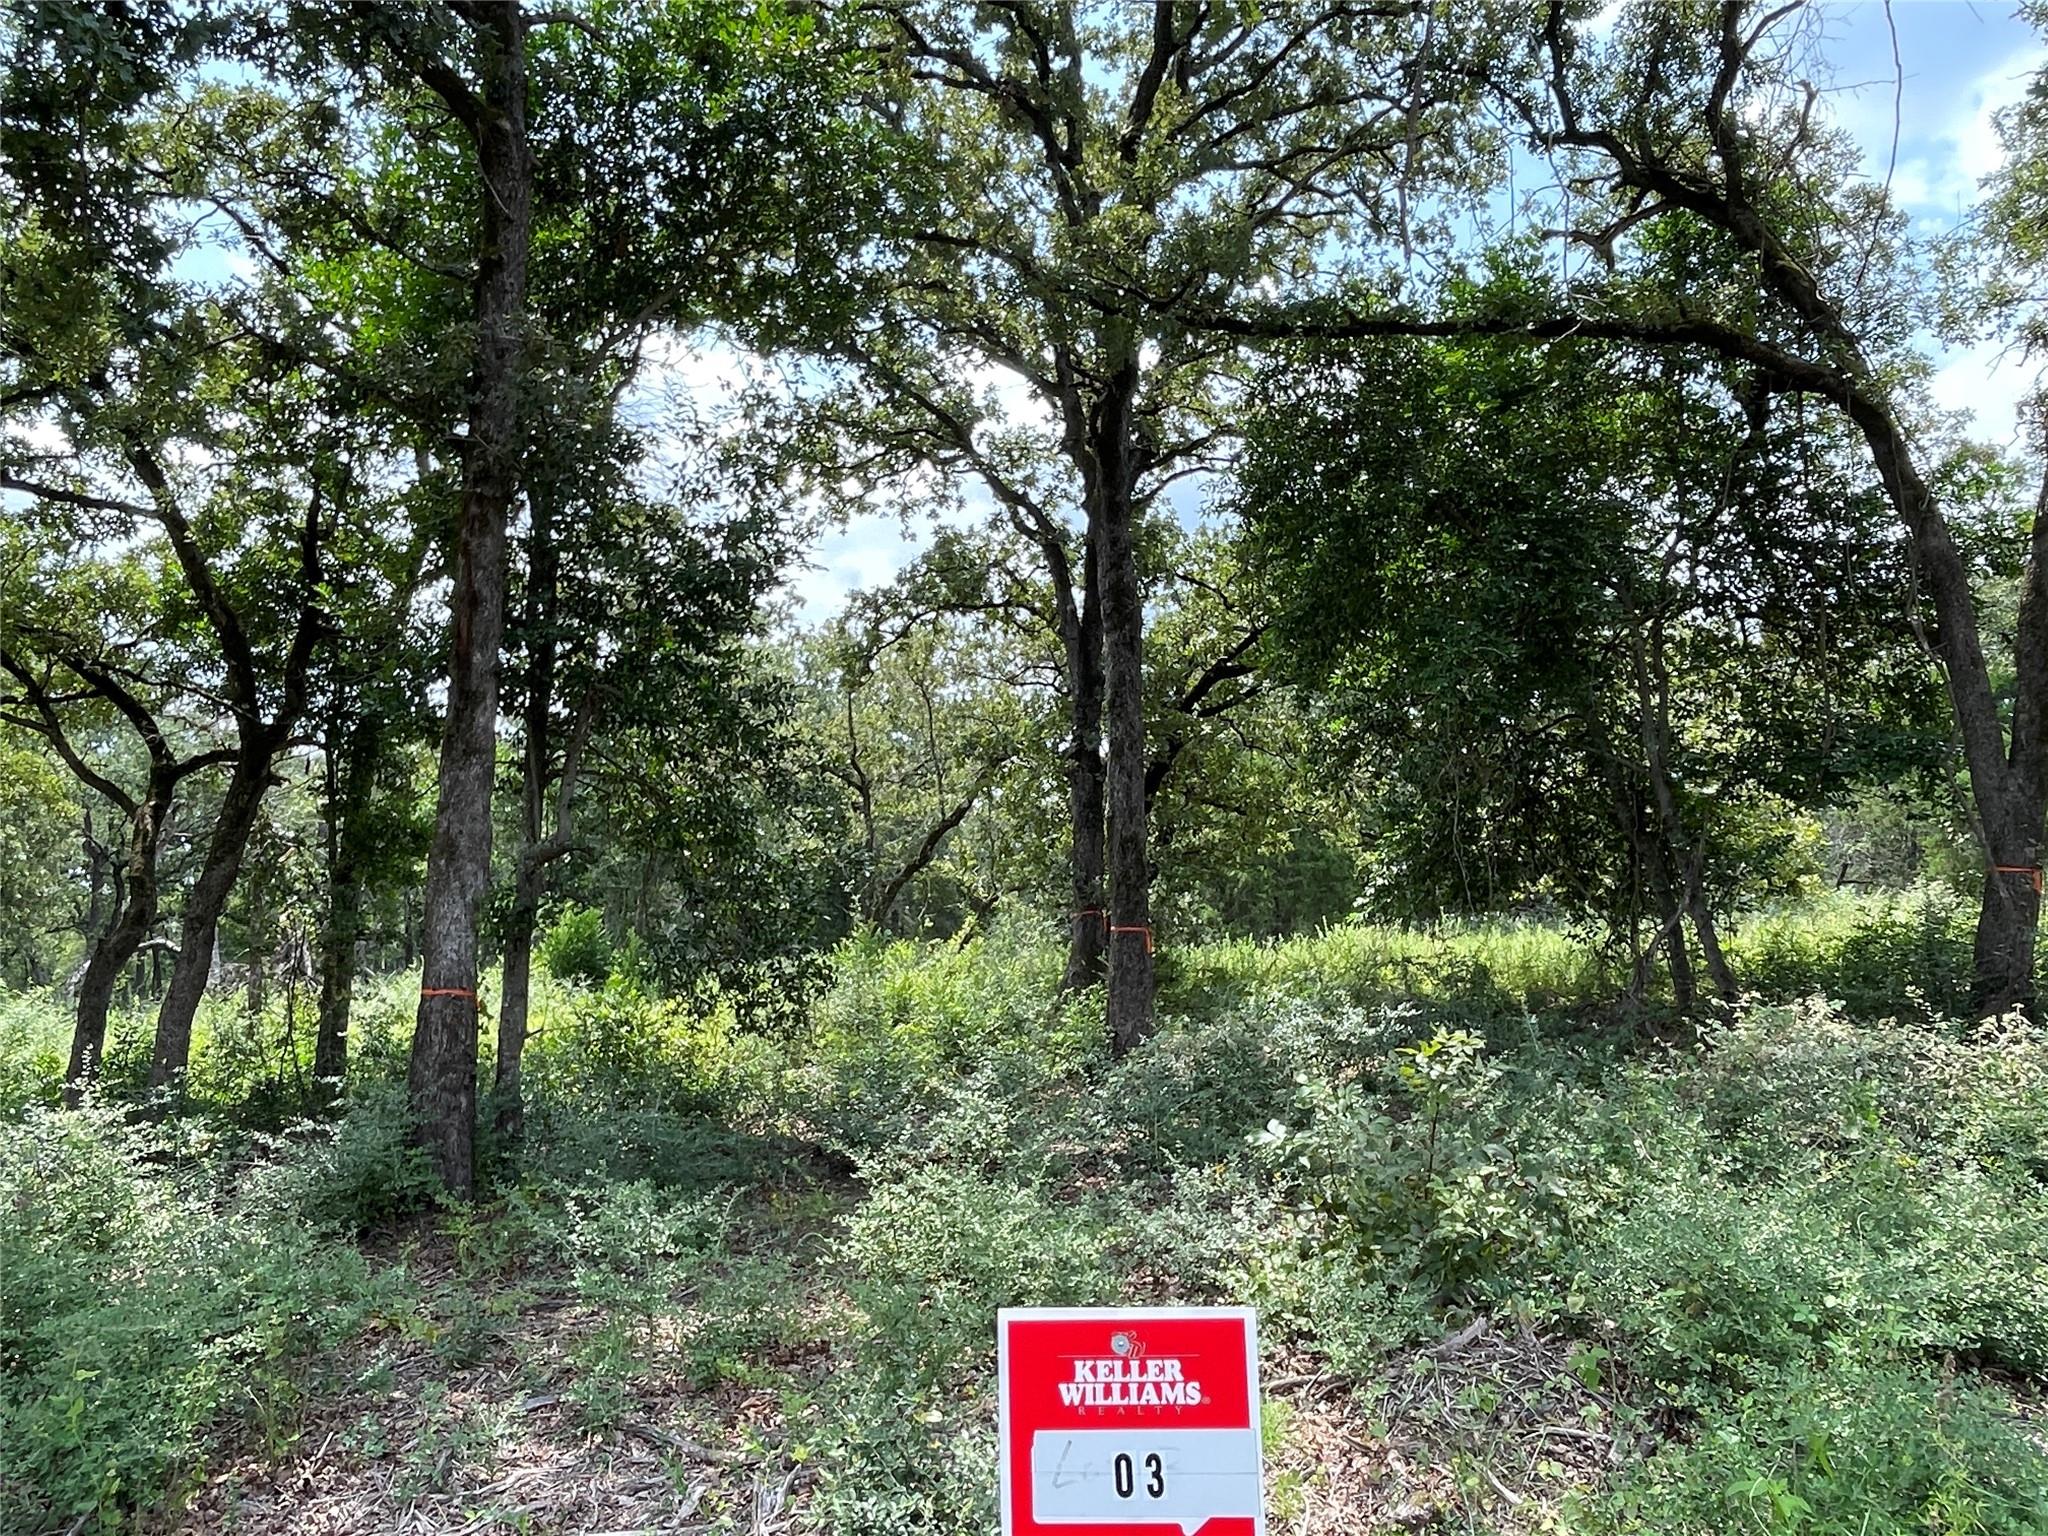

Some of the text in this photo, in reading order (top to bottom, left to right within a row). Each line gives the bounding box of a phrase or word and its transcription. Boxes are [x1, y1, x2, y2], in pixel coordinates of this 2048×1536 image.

[1074, 1360, 1184, 1382] KELLER
[1058, 1382, 1201, 1406] WILLIAMS
[1079, 1406, 1182, 1415] REALTY
